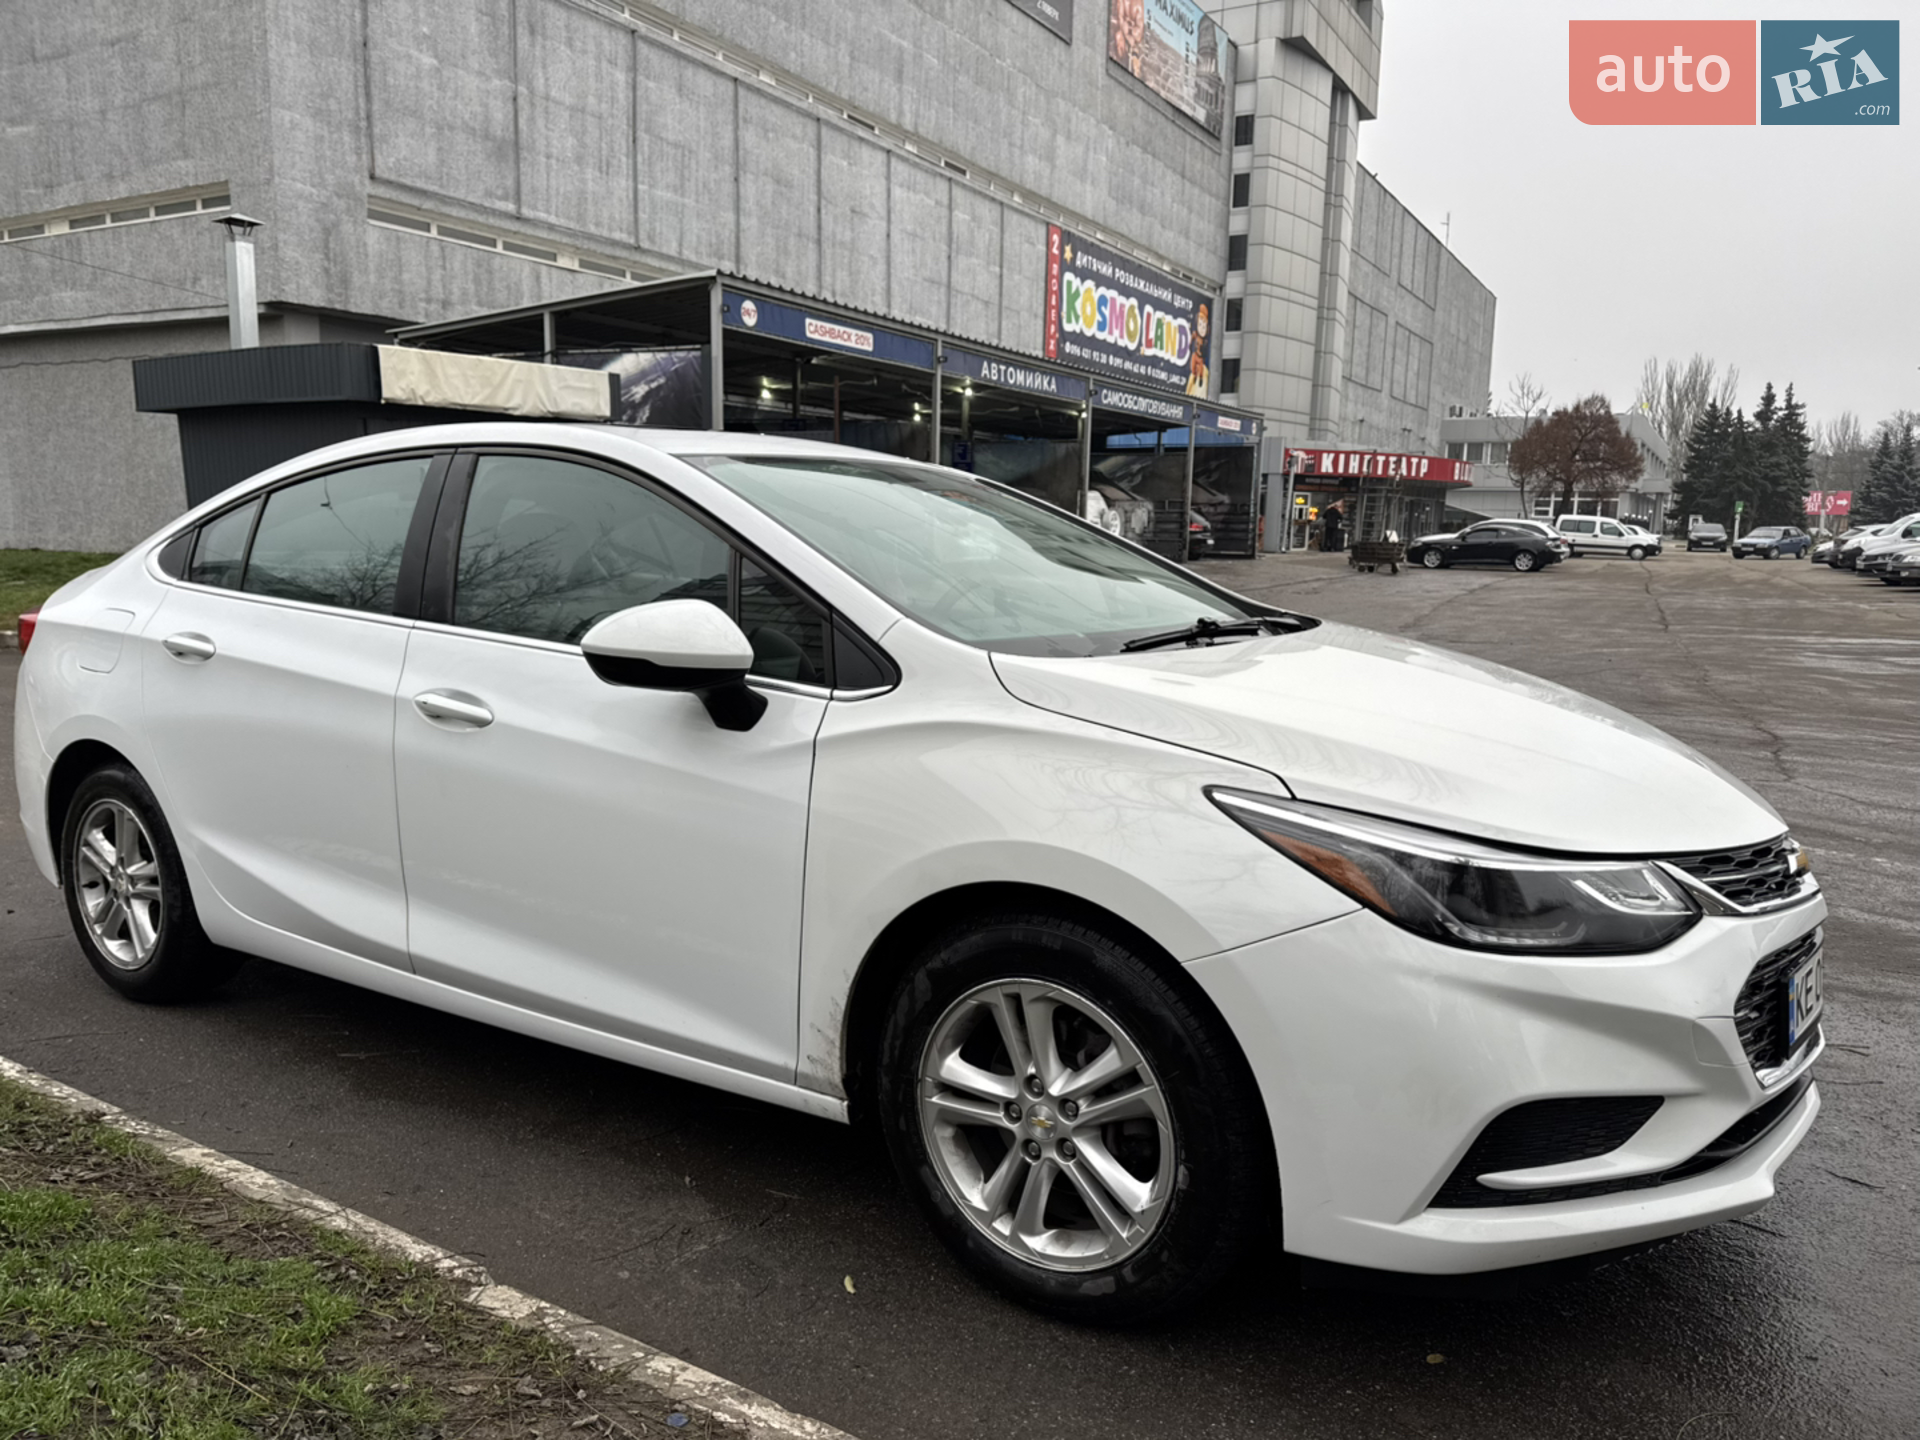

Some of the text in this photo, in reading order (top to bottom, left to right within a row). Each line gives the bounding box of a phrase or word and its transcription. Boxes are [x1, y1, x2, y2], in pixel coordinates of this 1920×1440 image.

[1075, 250, 1194, 311] ДИТЯЧИЙ РОЗВАЖАЛЬНИЙ ЦЕНТР
[741, 306, 758, 320] 24/7
[1064, 275, 1191, 361] KOSMO LAND
[807, 321, 872, 348] CASHBACK 20%
[980, 360, 1057, 392] АВТОМИЙКА
[1100, 388, 1184, 419] САМООБСЛУГОВУВАННЯ
